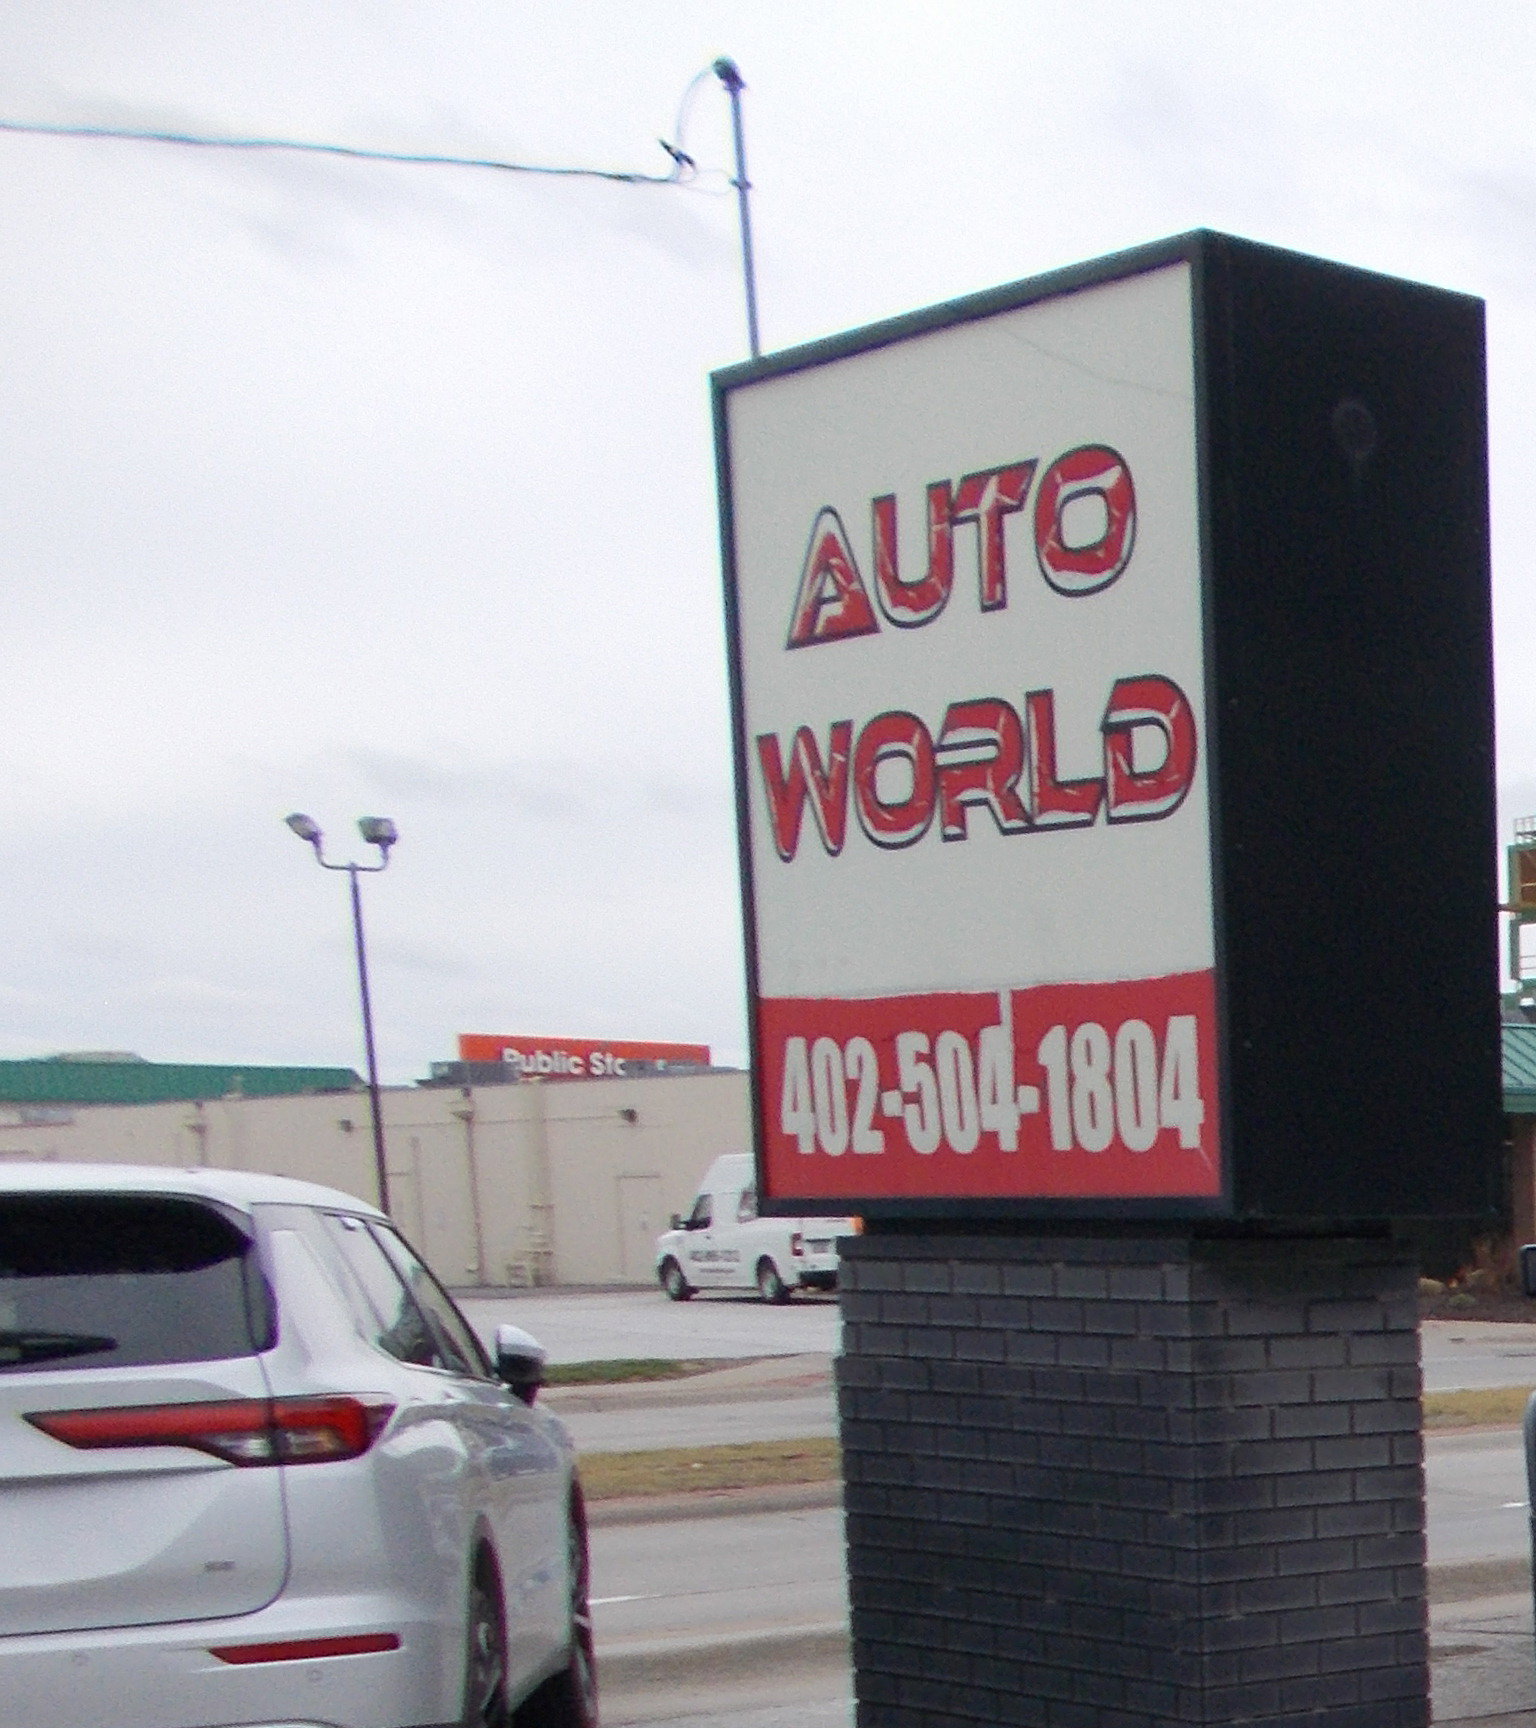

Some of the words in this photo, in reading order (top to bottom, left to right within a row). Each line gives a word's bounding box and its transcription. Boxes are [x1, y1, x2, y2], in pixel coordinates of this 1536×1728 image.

[786, 443, 1136, 650] AUTO
[757, 674, 1197, 863] WORLD
[502, 1048, 584, 1075] Public
[780, 1014, 1205, 1156] 402-504-1804
